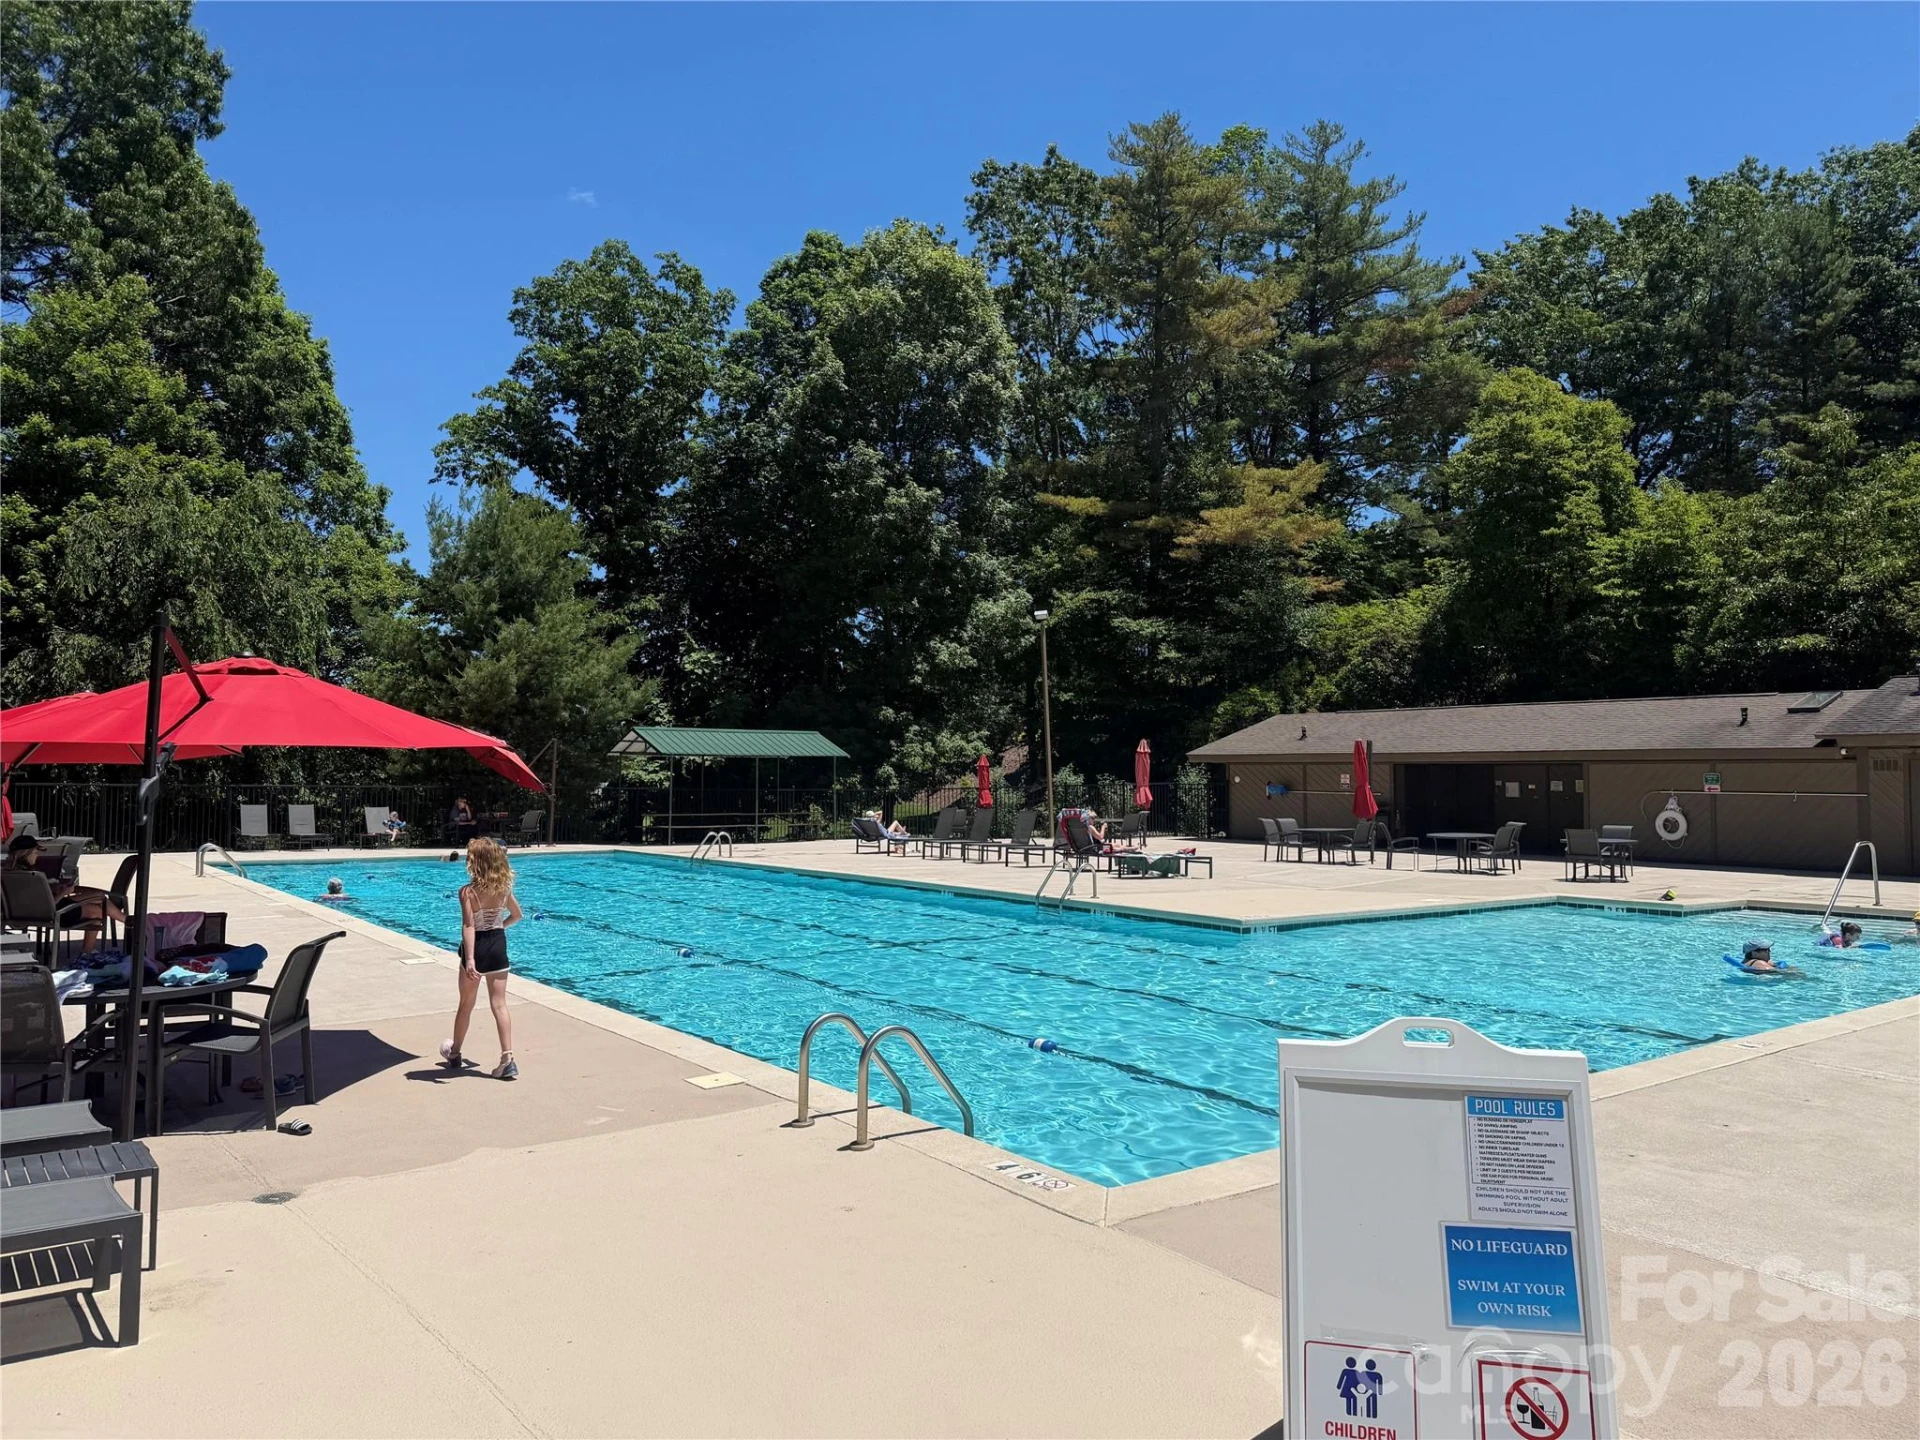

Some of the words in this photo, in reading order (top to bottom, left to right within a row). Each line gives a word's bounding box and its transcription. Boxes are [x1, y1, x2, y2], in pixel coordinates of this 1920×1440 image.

[1475, 1099, 1508, 1114] POOL
[1514, 1101, 1556, 1116] RULES
[1451, 1239, 1474, 1251] NO
[1477, 1240, 1568, 1256] LIFEGUARD
[1458, 1279, 1500, 1292] SWIM
[1502, 1282, 1521, 1294] AT
[1524, 1284, 1566, 1296] YOUR
[1478, 1302, 1514, 1315] OWN
[1517, 1304, 1552, 1317] RISK
[1324, 1420, 1396, 1440] CHILDREN
